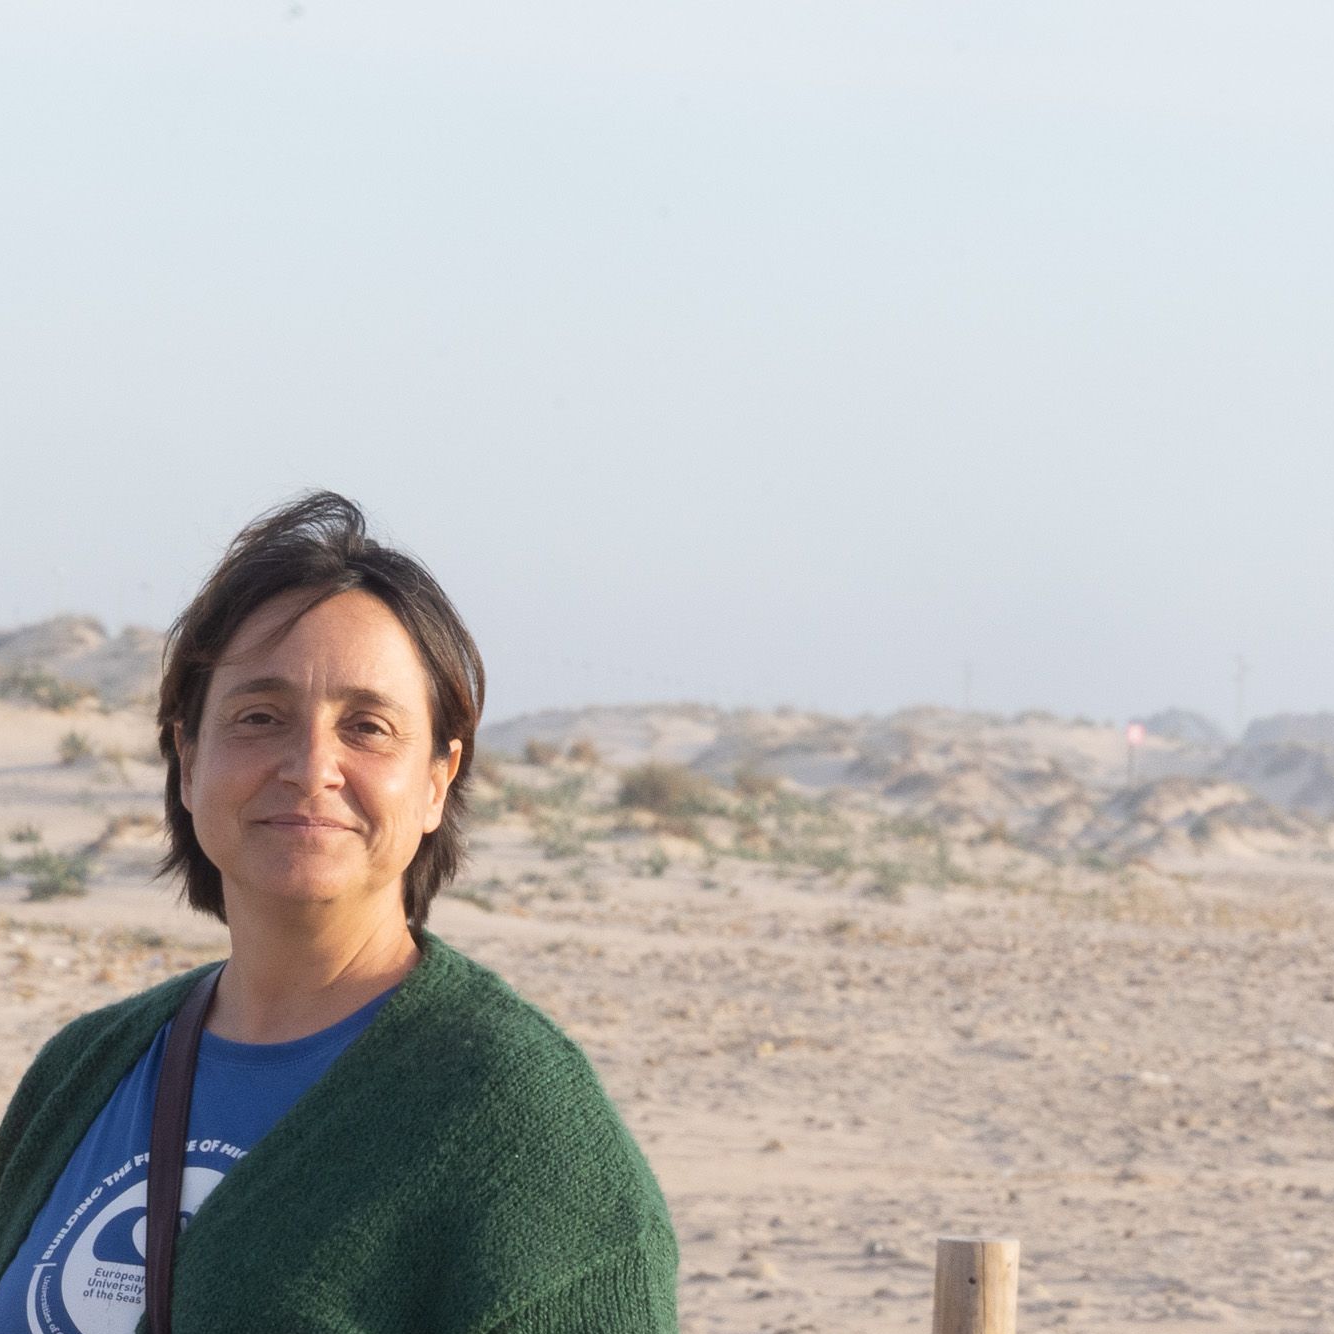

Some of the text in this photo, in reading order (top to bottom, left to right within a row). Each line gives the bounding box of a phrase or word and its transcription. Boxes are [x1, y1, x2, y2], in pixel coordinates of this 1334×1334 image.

[41, 1186, 103, 1260] BUILDING
[103, 1160, 133, 1187] THE
[199, 1139, 221, 1153] OF
[87, 1277, 145, 1295] University
[83, 1289, 142, 1305] of the Seas
[49, 1323, 60, 1333] of
